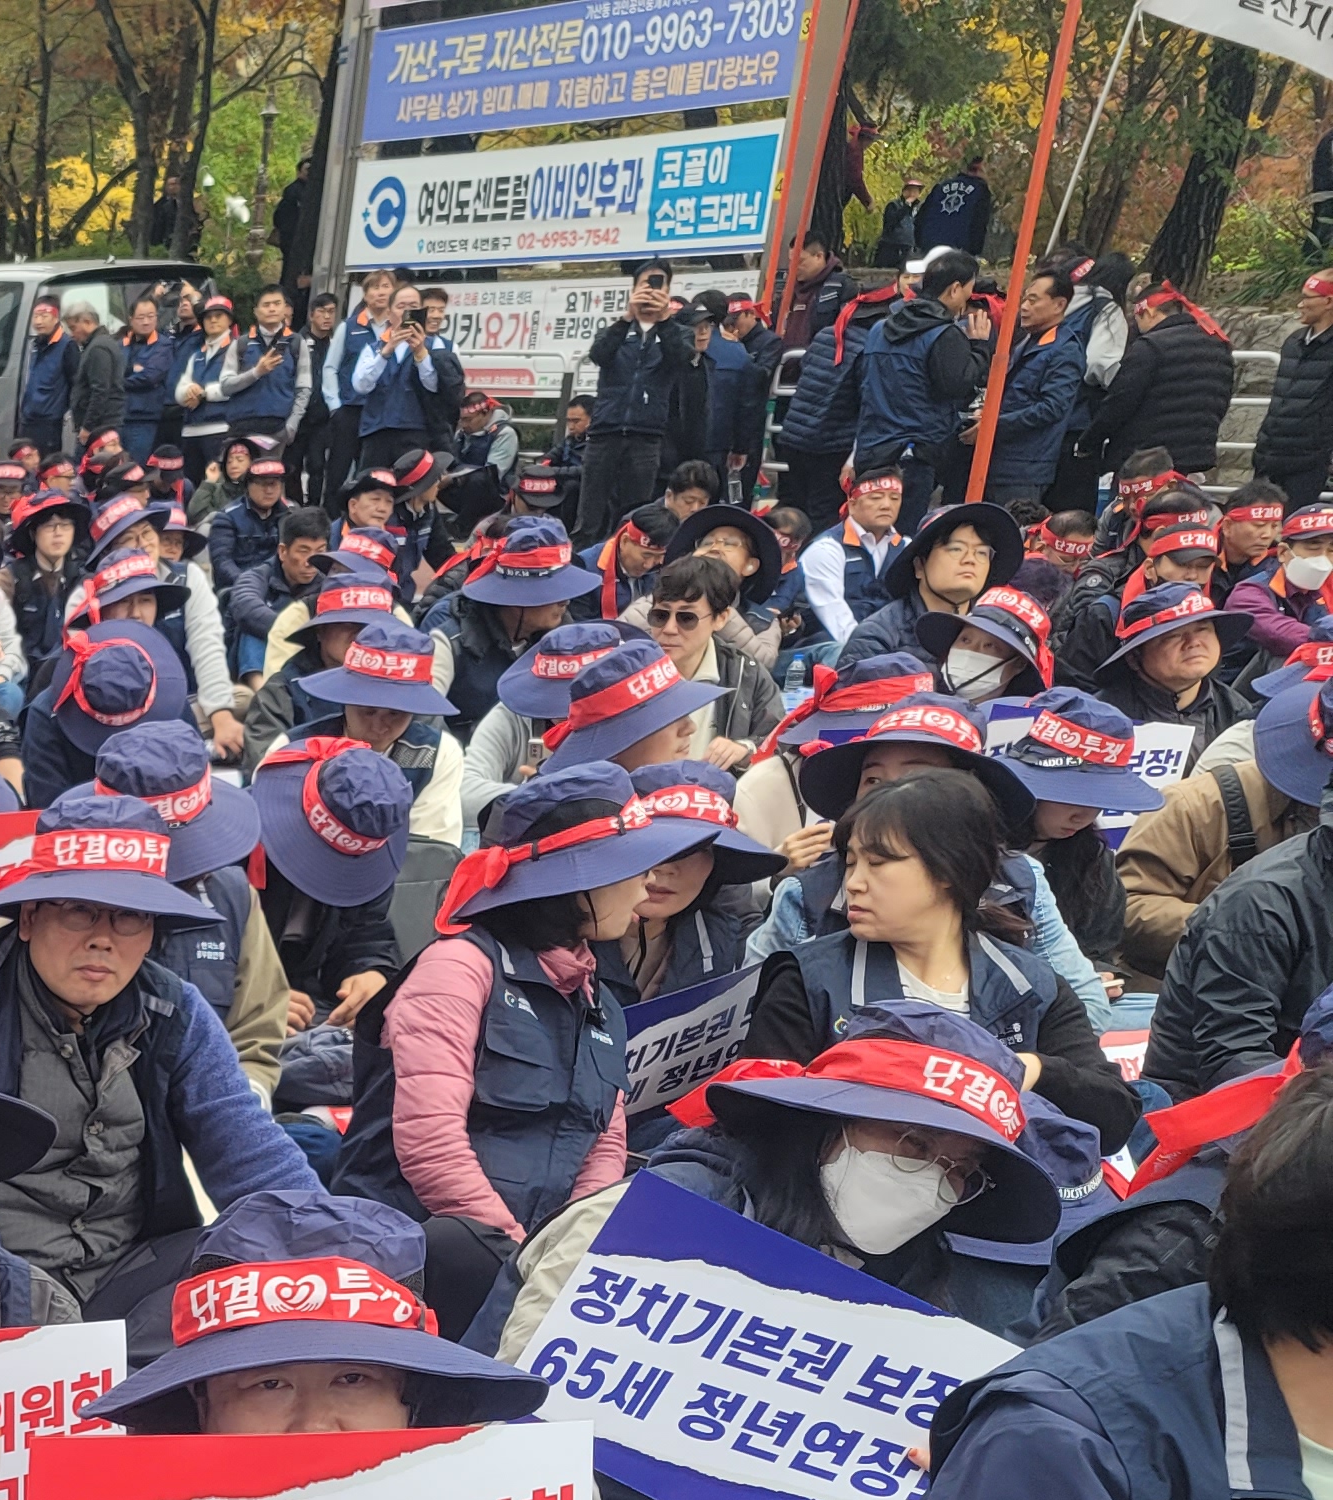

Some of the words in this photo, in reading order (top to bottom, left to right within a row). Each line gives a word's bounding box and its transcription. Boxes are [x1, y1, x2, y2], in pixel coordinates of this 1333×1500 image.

[486, 19, 584, 72] 지산전문
[581, 0, 795, 64] 010-9963-7303
[556, 73, 627, 109] 저렴하고
[657, 145, 732, 190] 코골이
[427, 239, 469, 254] 여의도역
[472, 236, 512, 252] 4번출구
[517, 227, 620, 249] 02-6953-7542
[1131, 479, 1154, 494] 투쟁
[1250, 506, 1273, 519] 단결
[1300, 515, 1327, 530] 단결
[1055, 539, 1075, 554] 단결
[1180, 533, 1206, 548] 단결
[341, 589, 372, 608] 단결
[1019, 598, 1044, 627] 투쟁
[1173, 592, 1206, 617] 단결
[383, 654, 418, 679] 투쟁
[628, 667, 667, 700] 단결
[877, 708, 922, 733] 단결
[1030, 710, 1059, 742] 단결
[1079, 732, 1125, 764] 투쟁
[689, 791, 730, 821] 투쟁
[308, 803, 342, 845] 단결
[53, 833, 106, 866] 단결
[922, 1054, 995, 1113] 단결
[189, 1269, 260, 1333] 단결
[328, 1264, 415, 1326] 투쟁
[569, 1266, 854, 1395] 정치기본권
[529, 1337, 674, 1421] 65세
